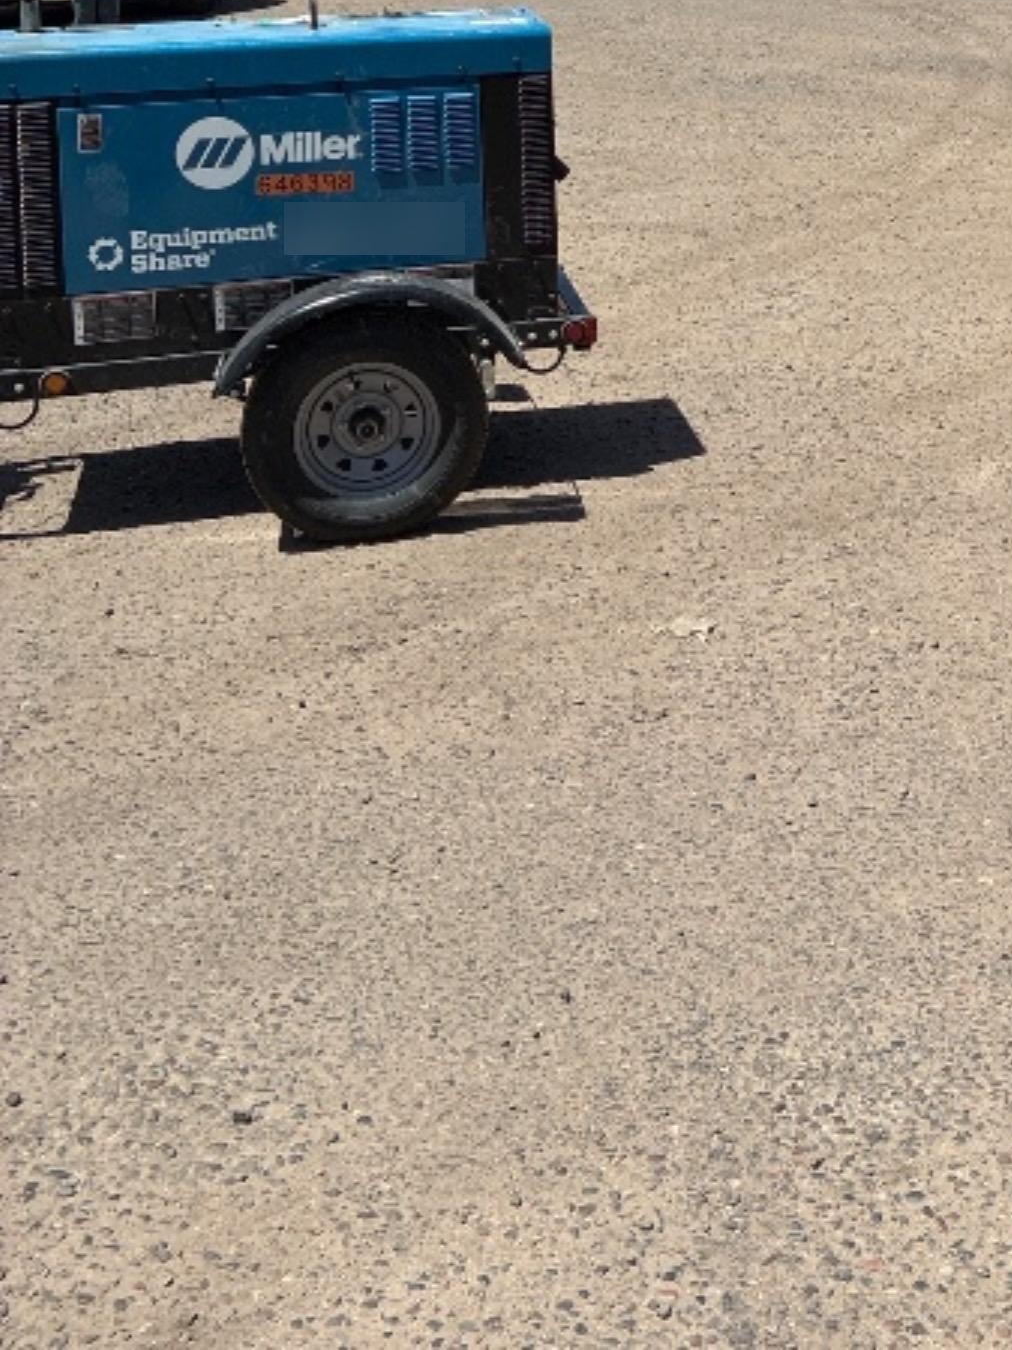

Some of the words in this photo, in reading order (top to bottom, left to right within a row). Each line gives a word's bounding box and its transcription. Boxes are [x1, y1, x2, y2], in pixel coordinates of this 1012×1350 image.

[260, 131, 361, 166] Miller
[129, 221, 279, 252] Equipment
[130, 250, 212, 274] Share
